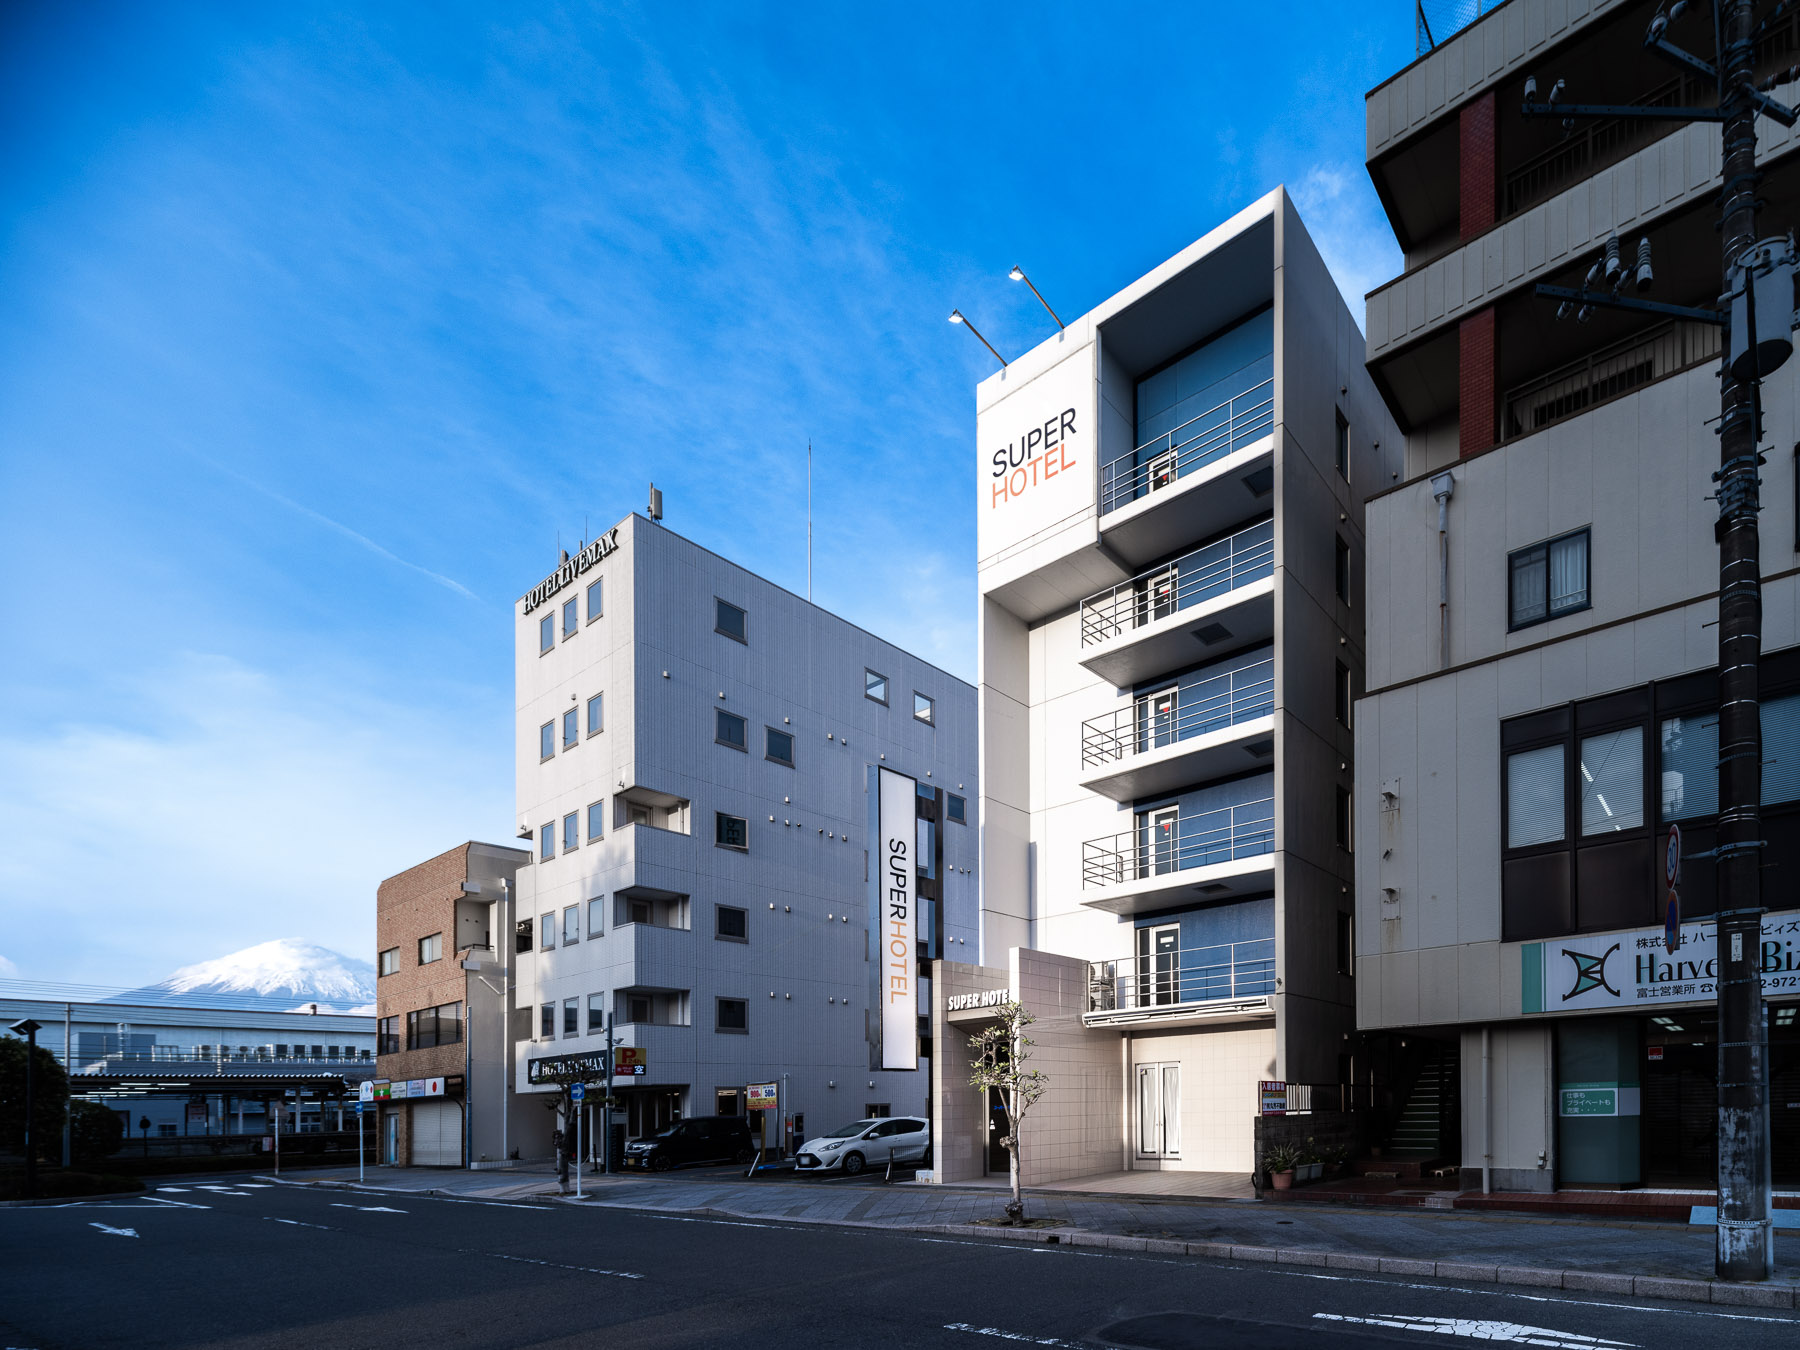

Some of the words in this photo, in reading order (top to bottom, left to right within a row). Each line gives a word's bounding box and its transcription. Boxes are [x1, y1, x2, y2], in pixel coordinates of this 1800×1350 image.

[992, 408, 1077, 478] SUPER
[992, 443, 1077, 509] HOTEL
[522, 572, 562, 616] HOTEL
[559, 527, 619, 589] LIVEMAX
[889, 838, 907, 920] SUPER
[1668, 842, 1676, 873] 30
[890, 920, 908, 1004] HOTEL
[1635, 953, 1718, 984] Harve
[1761, 941, 1800, 973] Bi
[948, 993, 980, 1011] SUPER
[981, 988, 1010, 1007] HOTE
[1637, 984, 1696, 998] 富士営業所
[622, 1048, 637, 1064] P
[634, 1065, 645, 1074] 空
